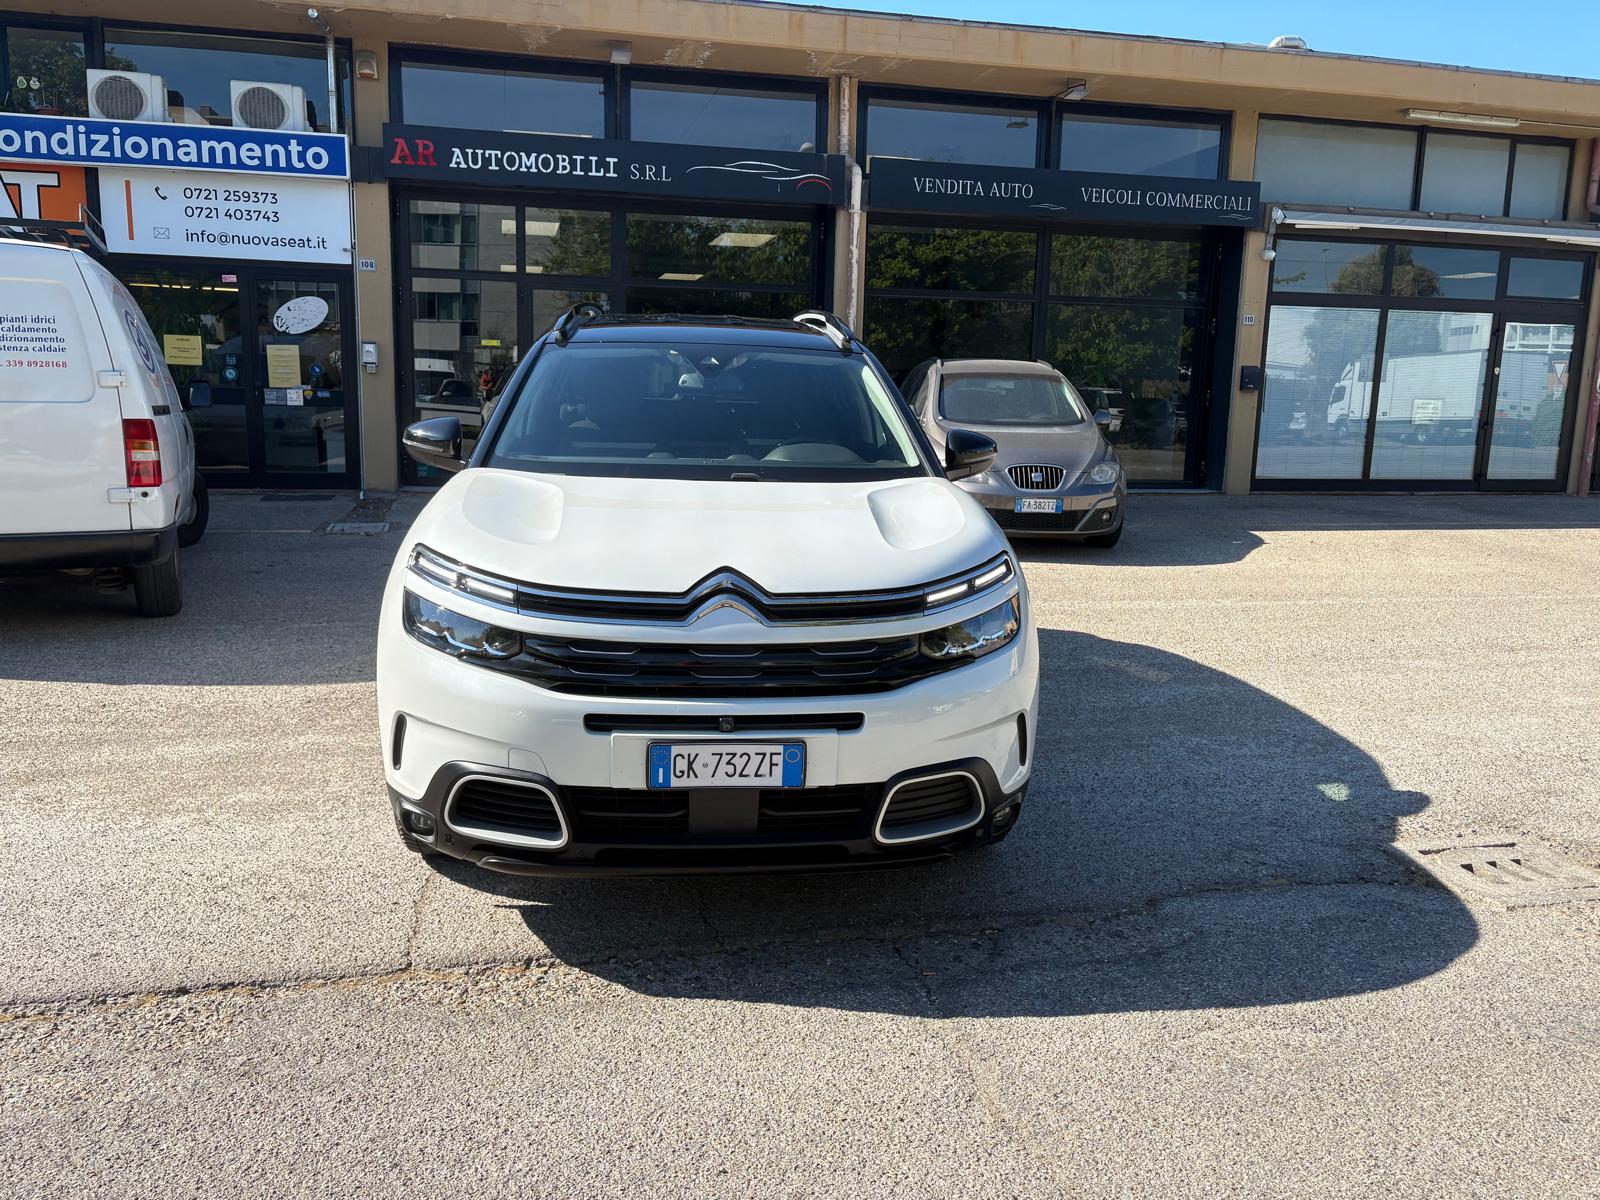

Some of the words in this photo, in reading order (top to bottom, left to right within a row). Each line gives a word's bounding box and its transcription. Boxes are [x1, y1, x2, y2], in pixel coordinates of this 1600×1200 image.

[0, 125, 329, 170] ondizionamento
[390, 137, 437, 167] AR
[449, 147, 618, 177] AUTOMOBILI
[183, 187, 218, 201] 0721
[223, 189, 279, 205] 259373
[913, 177, 985, 196] VENDITA
[989, 182, 1034, 199] AUTO
[1081, 187, 1142, 205] VEICOLI
[1146, 191, 1252, 211] COMMERCIALI
[184, 205, 220, 219] 0721
[224, 208, 280, 223] 403743
[185, 228, 328, 250] info@nuovaseat.it
[360, 260, 375, 269] 108
[30, 314, 56, 324] idrici
[1, 324, 57, 334] caldamento
[32, 344, 67, 353] caldaie
[6, 359, 24, 368] 339
[26, 360, 67, 368] 8928168
[673, 753, 700, 779] GK
[711, 752, 782, 778] 732ZF
